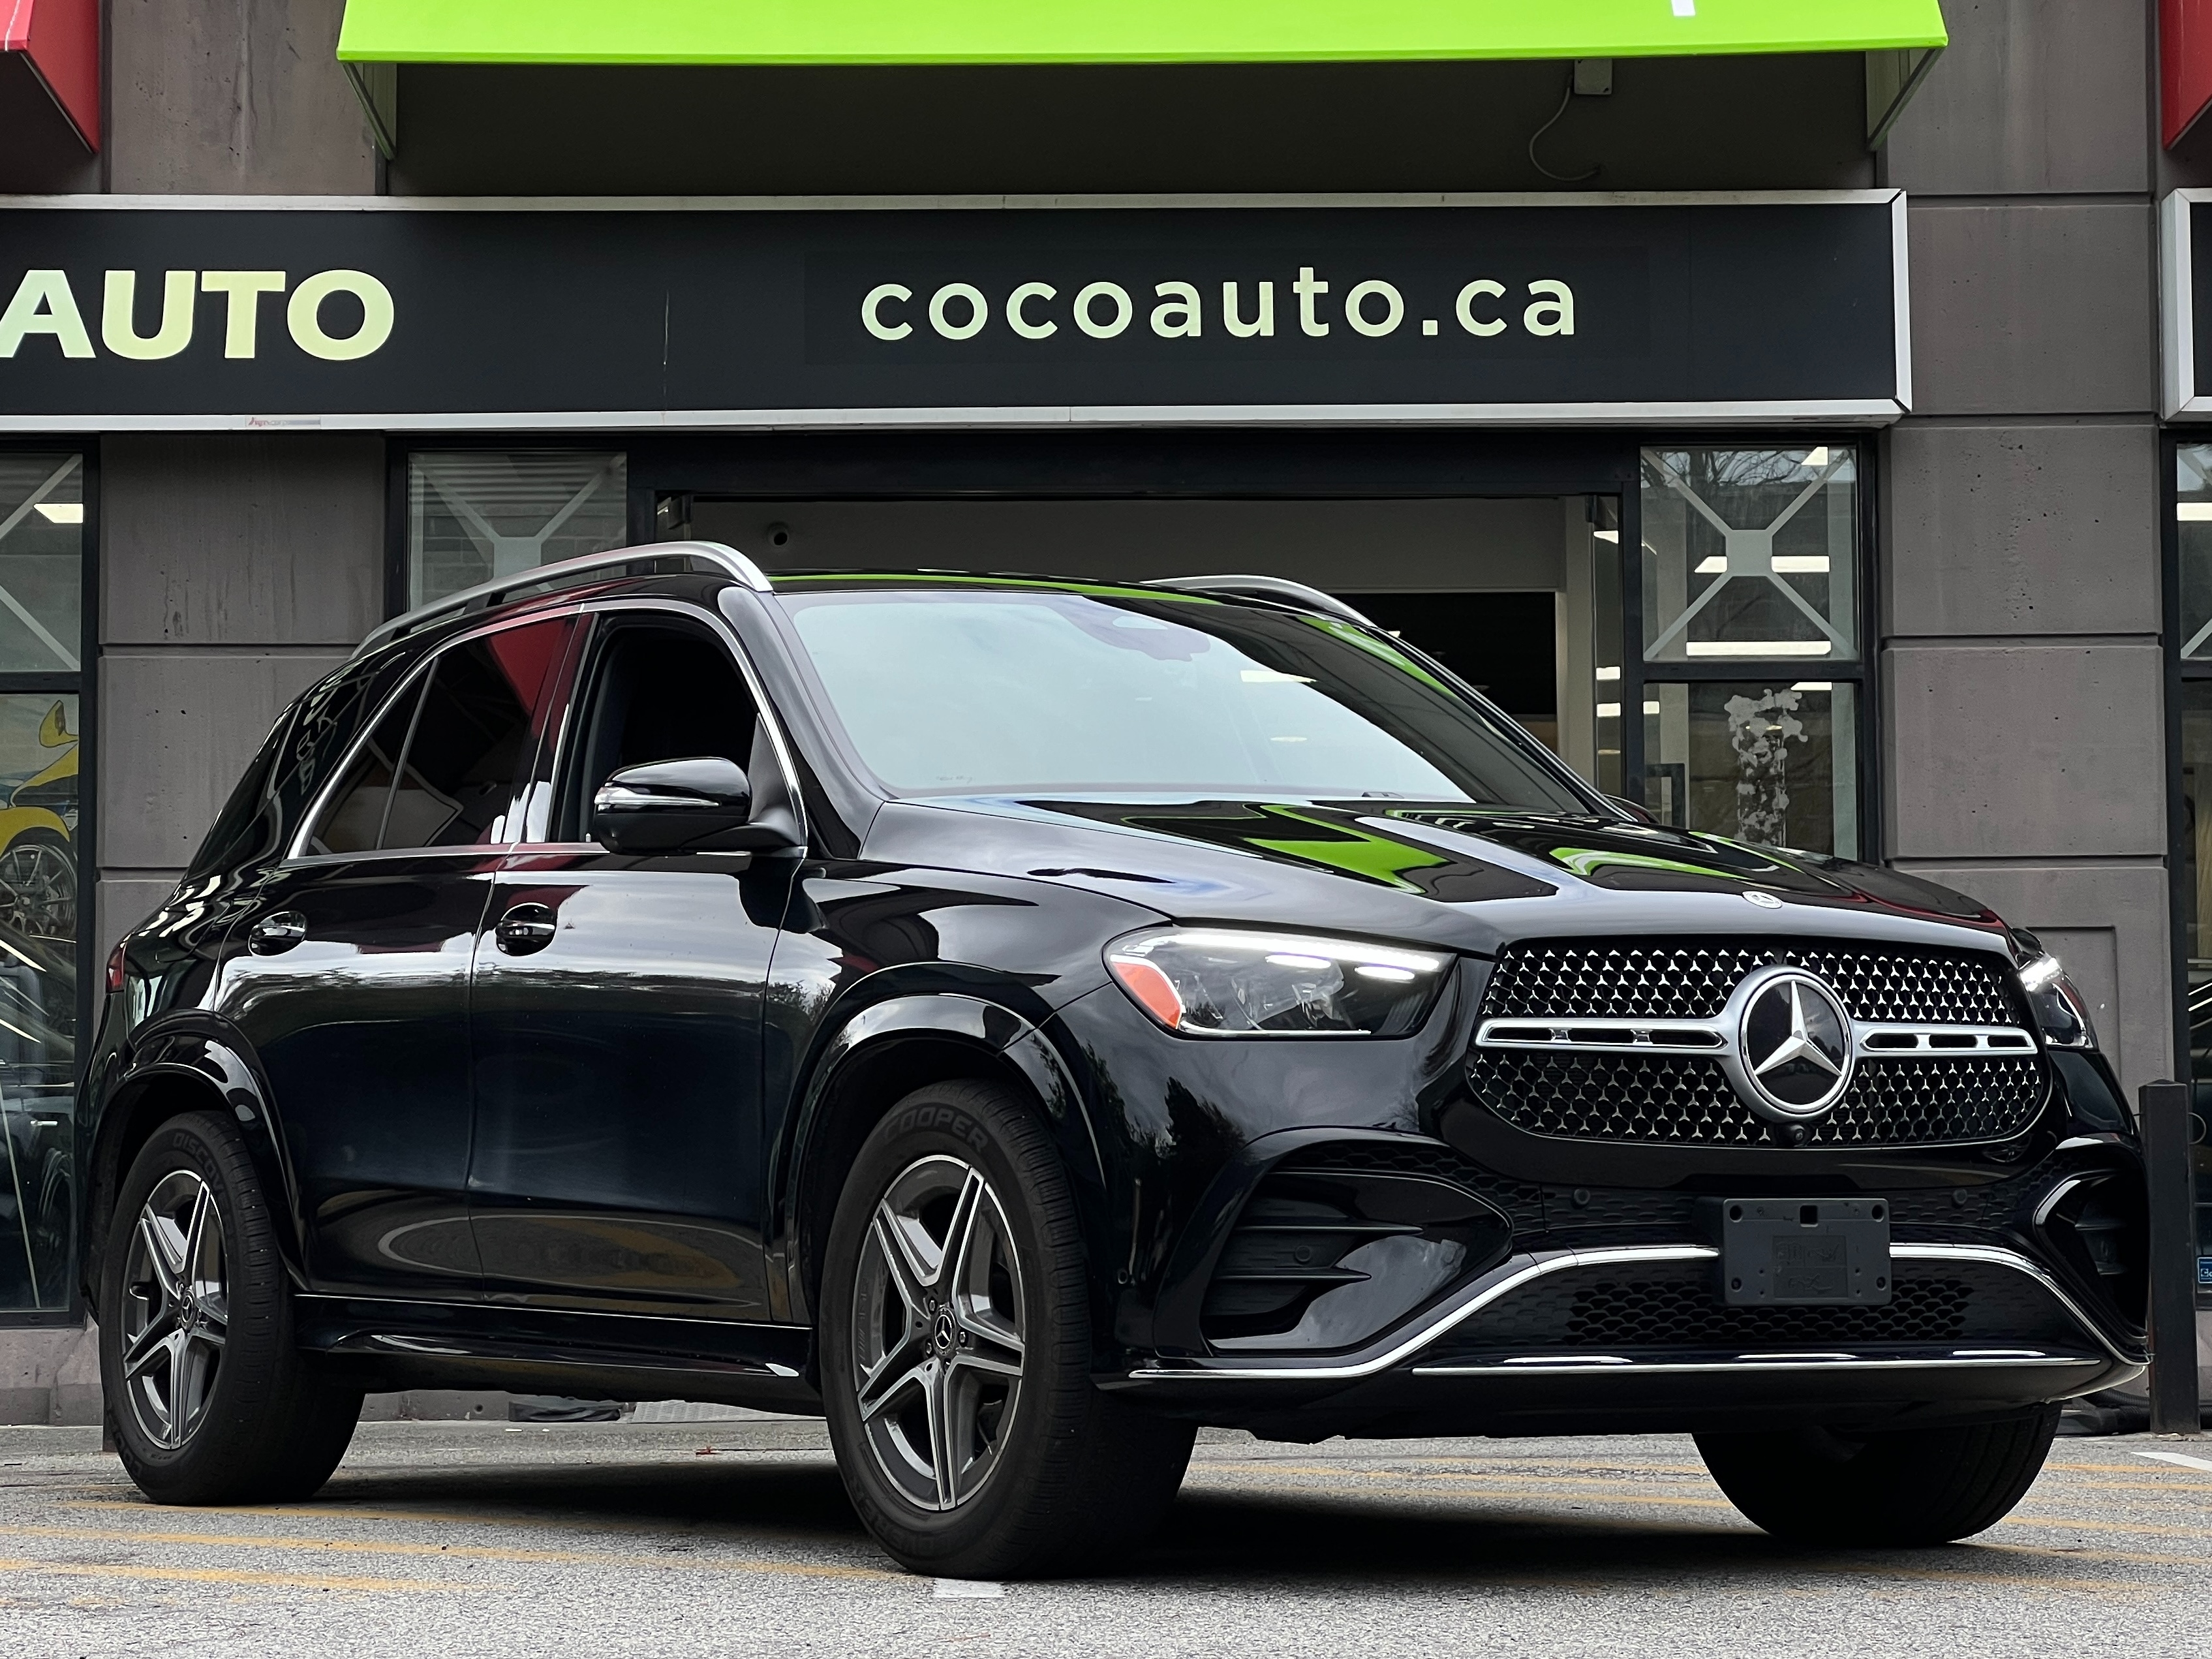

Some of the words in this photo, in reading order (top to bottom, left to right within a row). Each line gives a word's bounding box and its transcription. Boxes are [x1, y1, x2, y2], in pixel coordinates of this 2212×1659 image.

[0, 269, 395, 361] AUTO
[861, 266, 1576, 341] cocoauto.ca
[885, 1106, 989, 1154] COOPER
